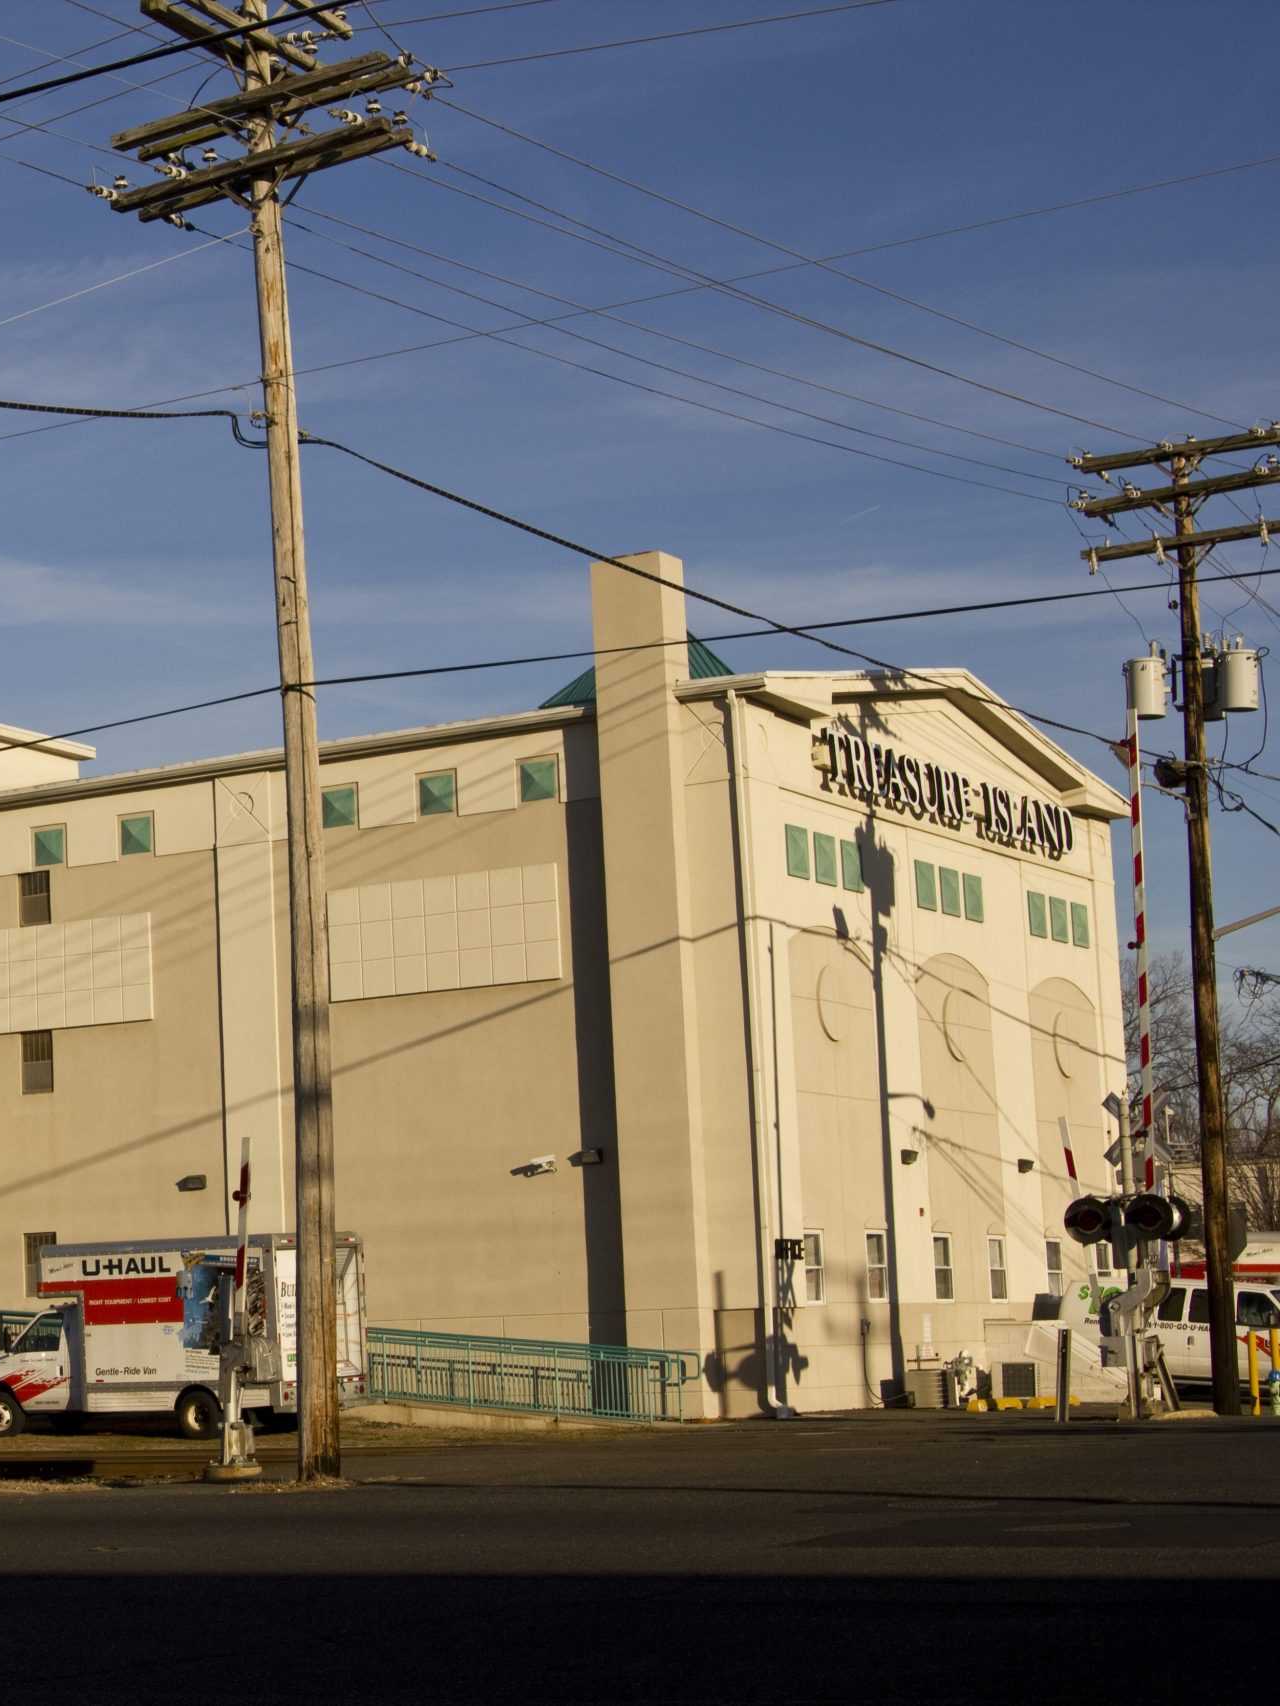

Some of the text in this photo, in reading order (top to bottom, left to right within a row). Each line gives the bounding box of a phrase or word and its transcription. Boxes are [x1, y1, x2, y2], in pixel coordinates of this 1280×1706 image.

[821, 728, 1073, 855] TREASURE ISLAND
[82, 1255, 172, 1276] U-HAUL
